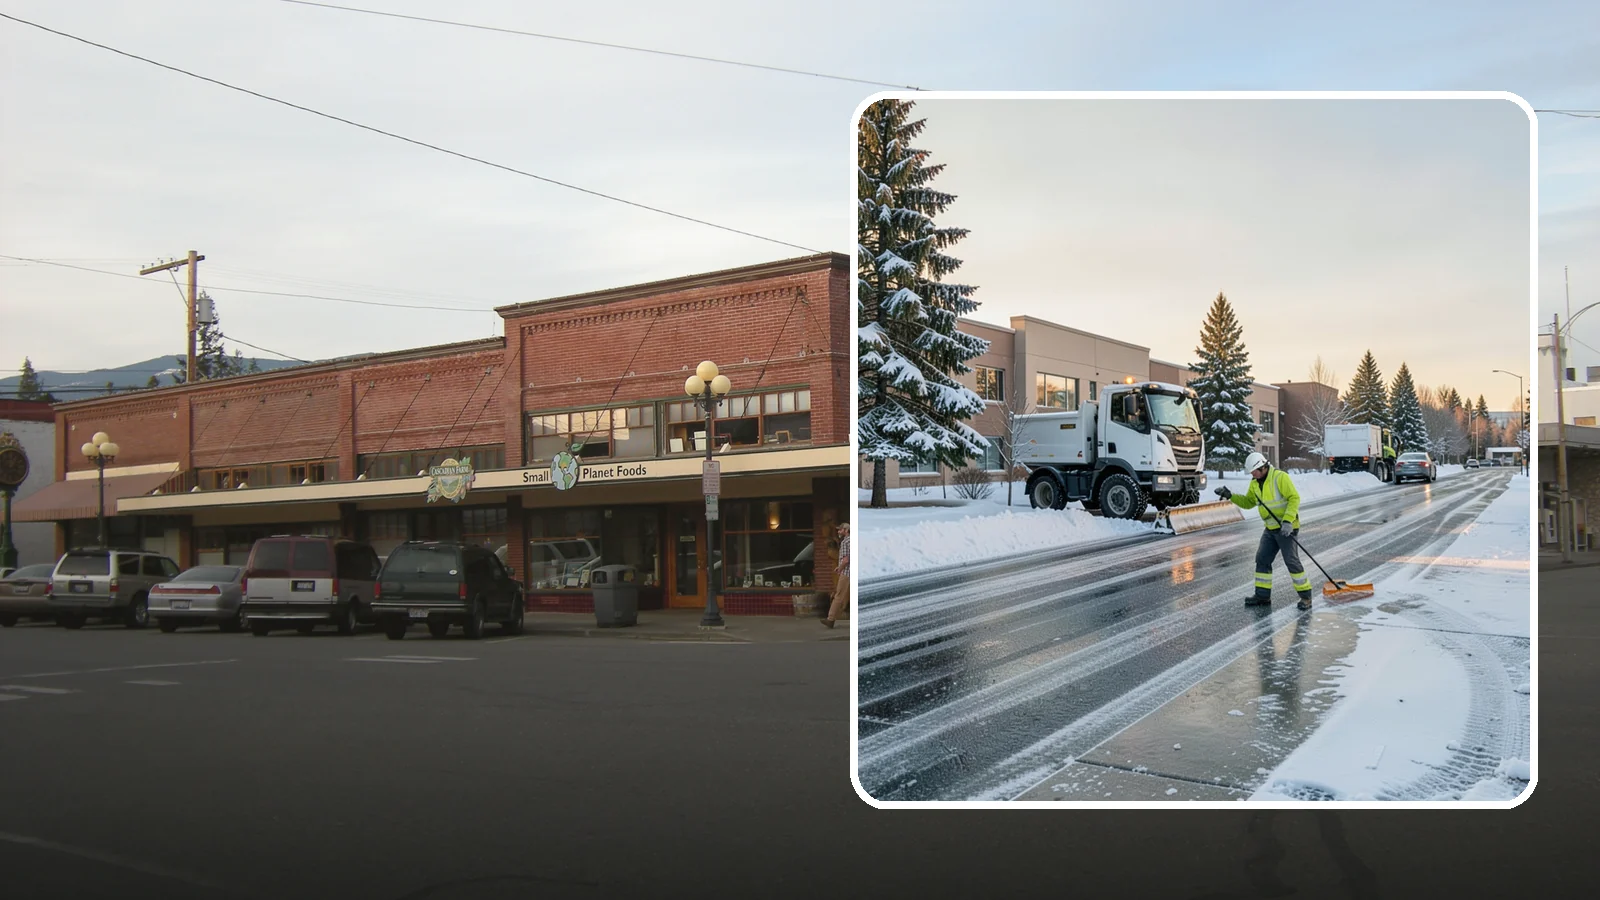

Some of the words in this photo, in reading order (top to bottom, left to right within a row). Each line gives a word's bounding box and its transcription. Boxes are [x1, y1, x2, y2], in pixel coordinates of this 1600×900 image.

[431, 467, 455, 475] CASCADIAN
[456, 466, 469, 474] FARM
[523, 471, 549, 483] Small
[583, 468, 614, 479] Planet
[617, 464, 647, 477] Foods
